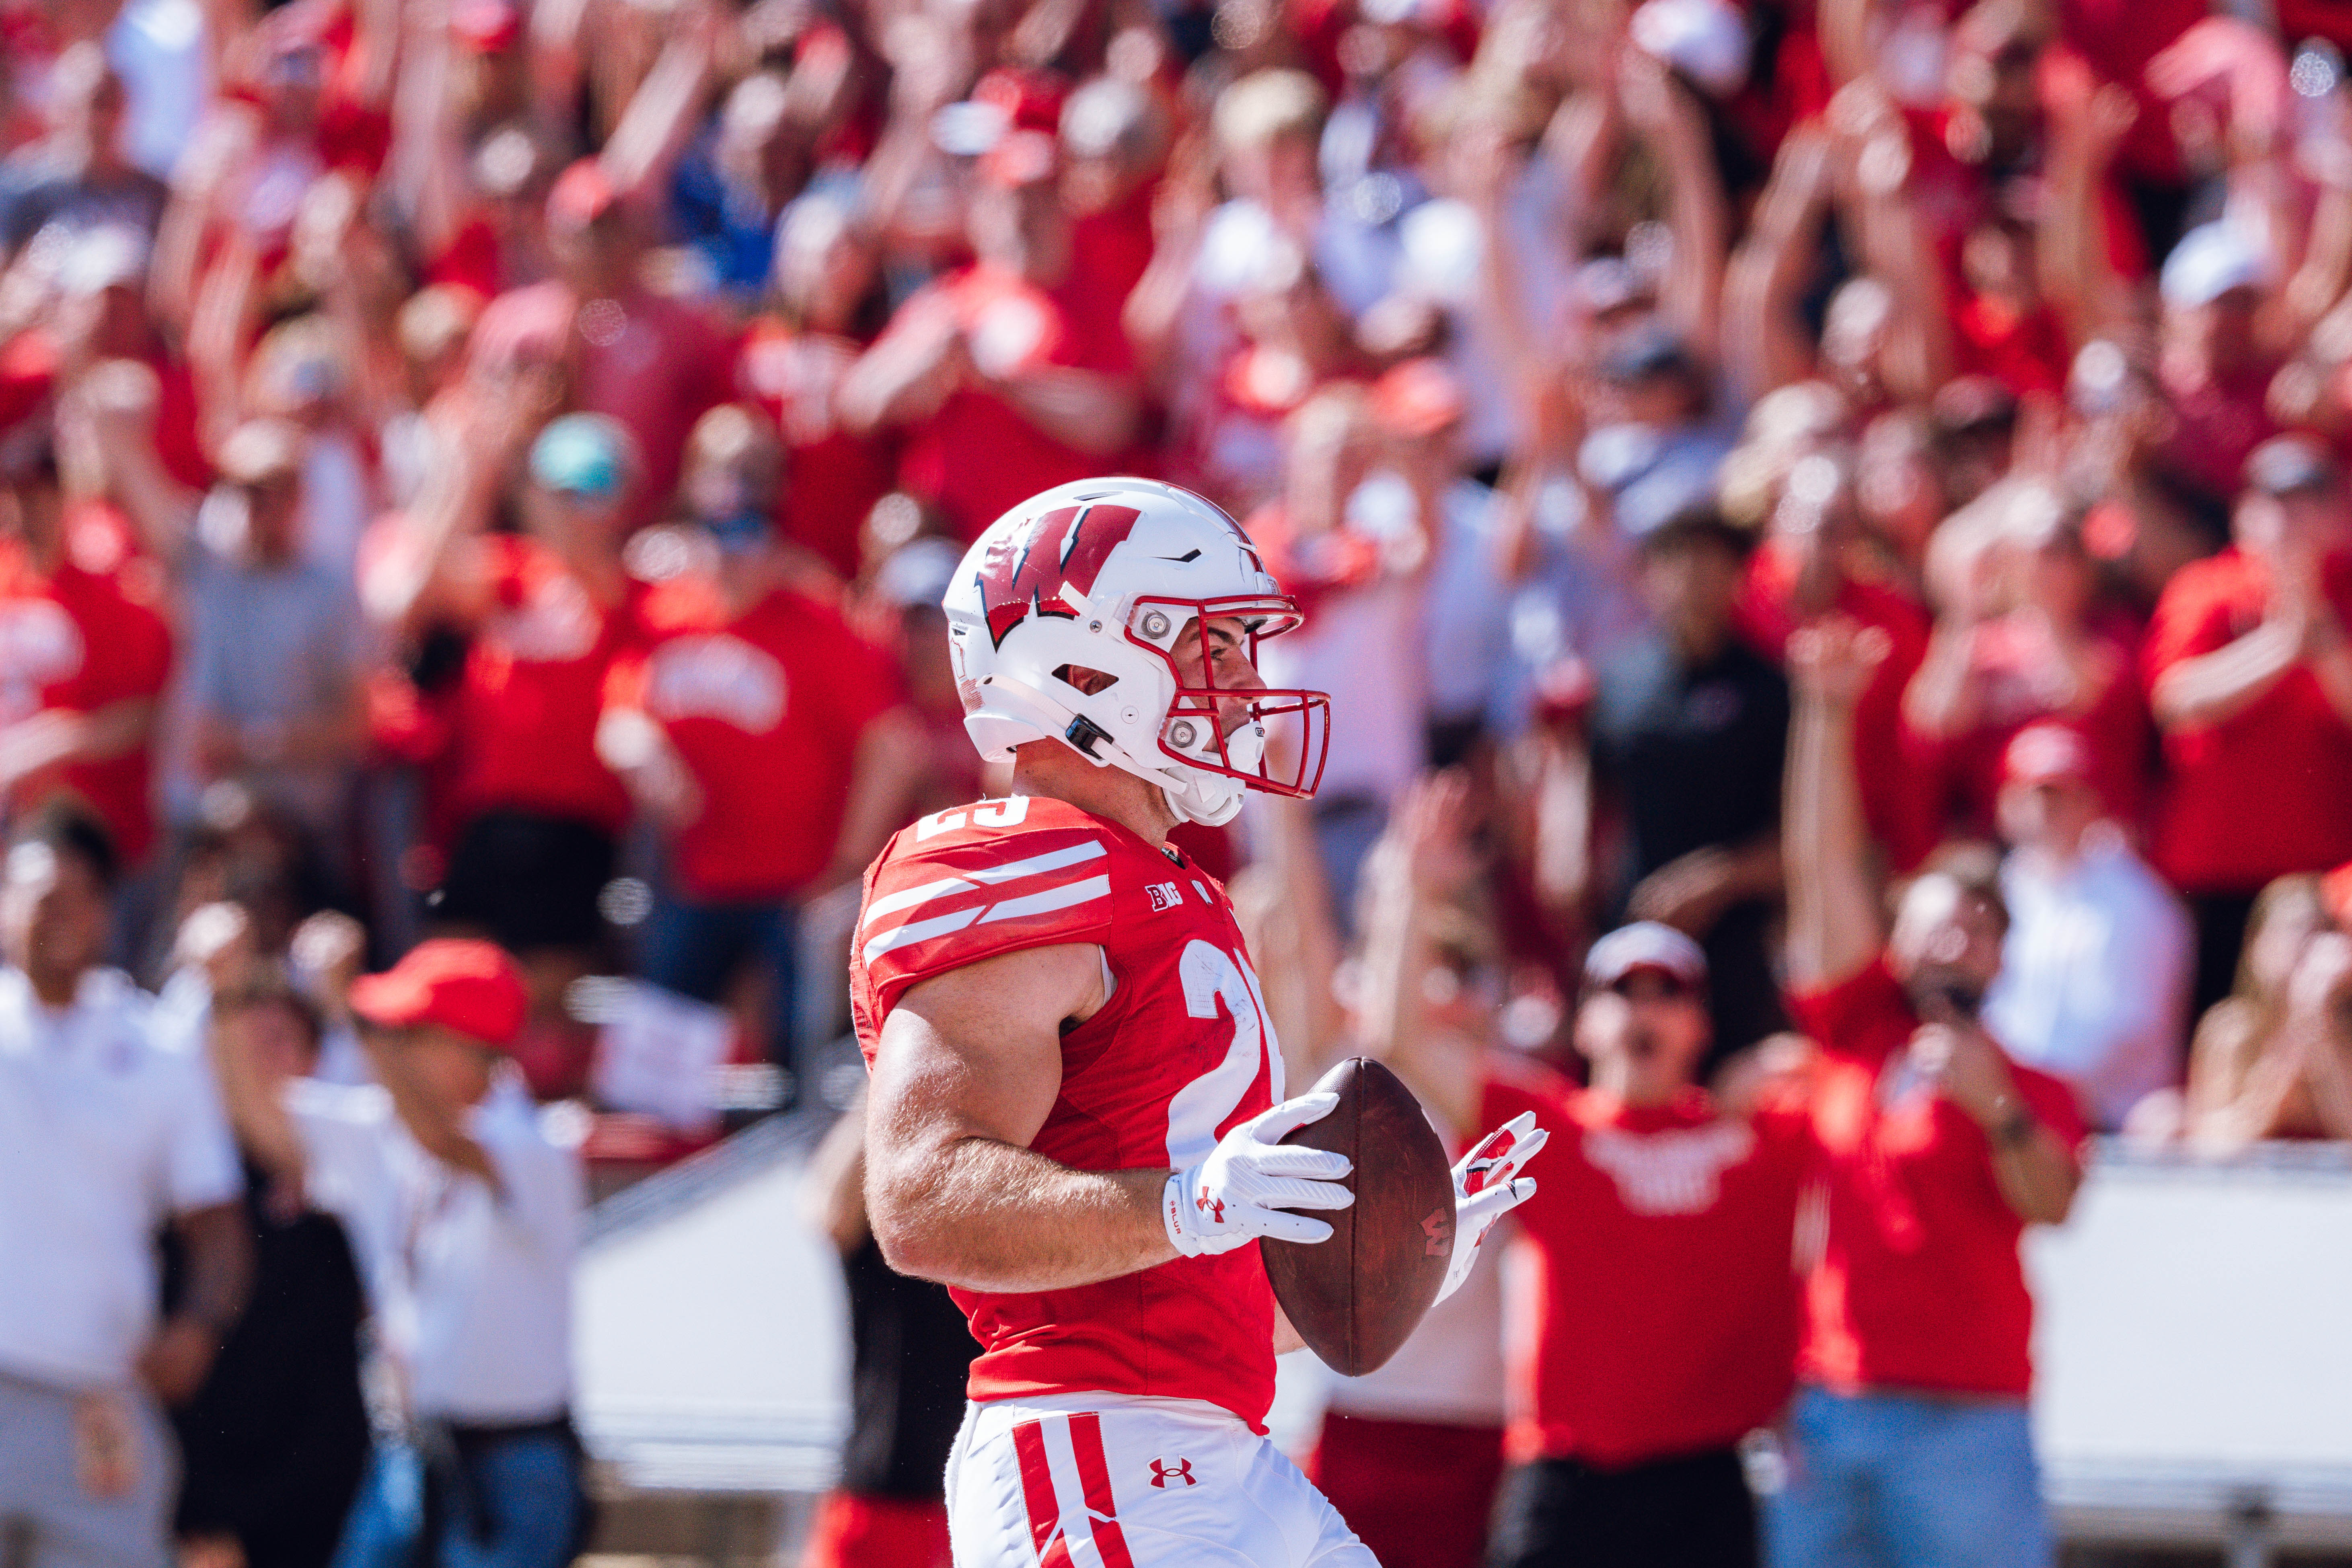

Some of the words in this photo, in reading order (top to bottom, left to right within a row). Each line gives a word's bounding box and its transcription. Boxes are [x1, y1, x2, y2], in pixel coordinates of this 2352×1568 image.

[974, 505, 1142, 654] W
[1171, 1207, 1181, 1234] BLUR
[1418, 1207, 1454, 1257] W
